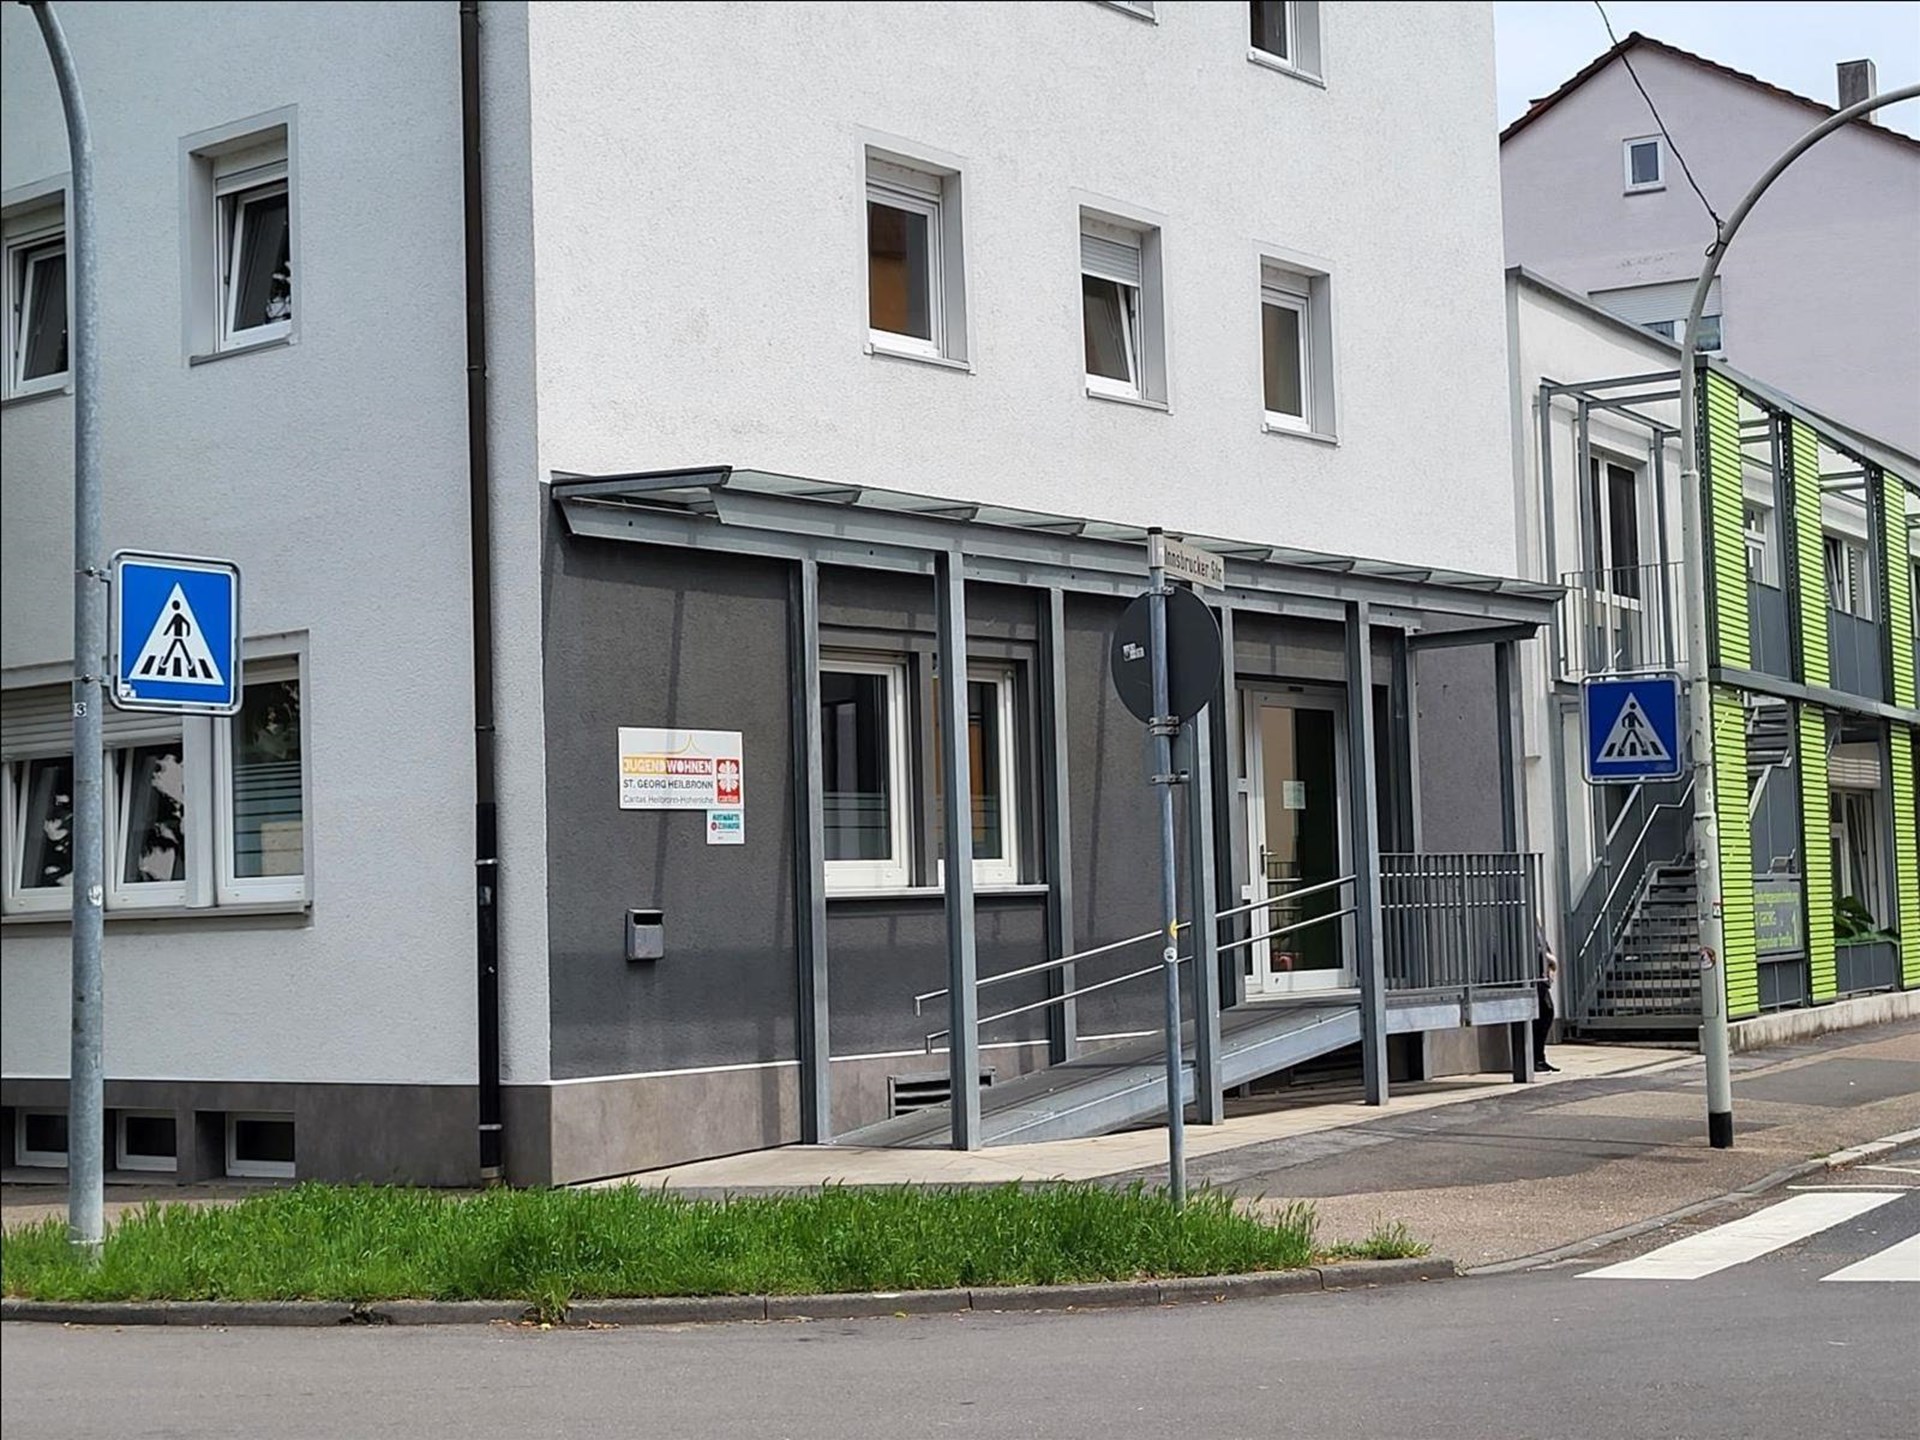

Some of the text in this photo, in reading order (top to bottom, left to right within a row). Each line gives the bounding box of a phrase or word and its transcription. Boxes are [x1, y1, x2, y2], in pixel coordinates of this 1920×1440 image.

[1164, 545, 1209, 577] Innsbrucker
[637, 779, 667, 789] GEORG
[668, 780, 714, 790] HEILBRONN
